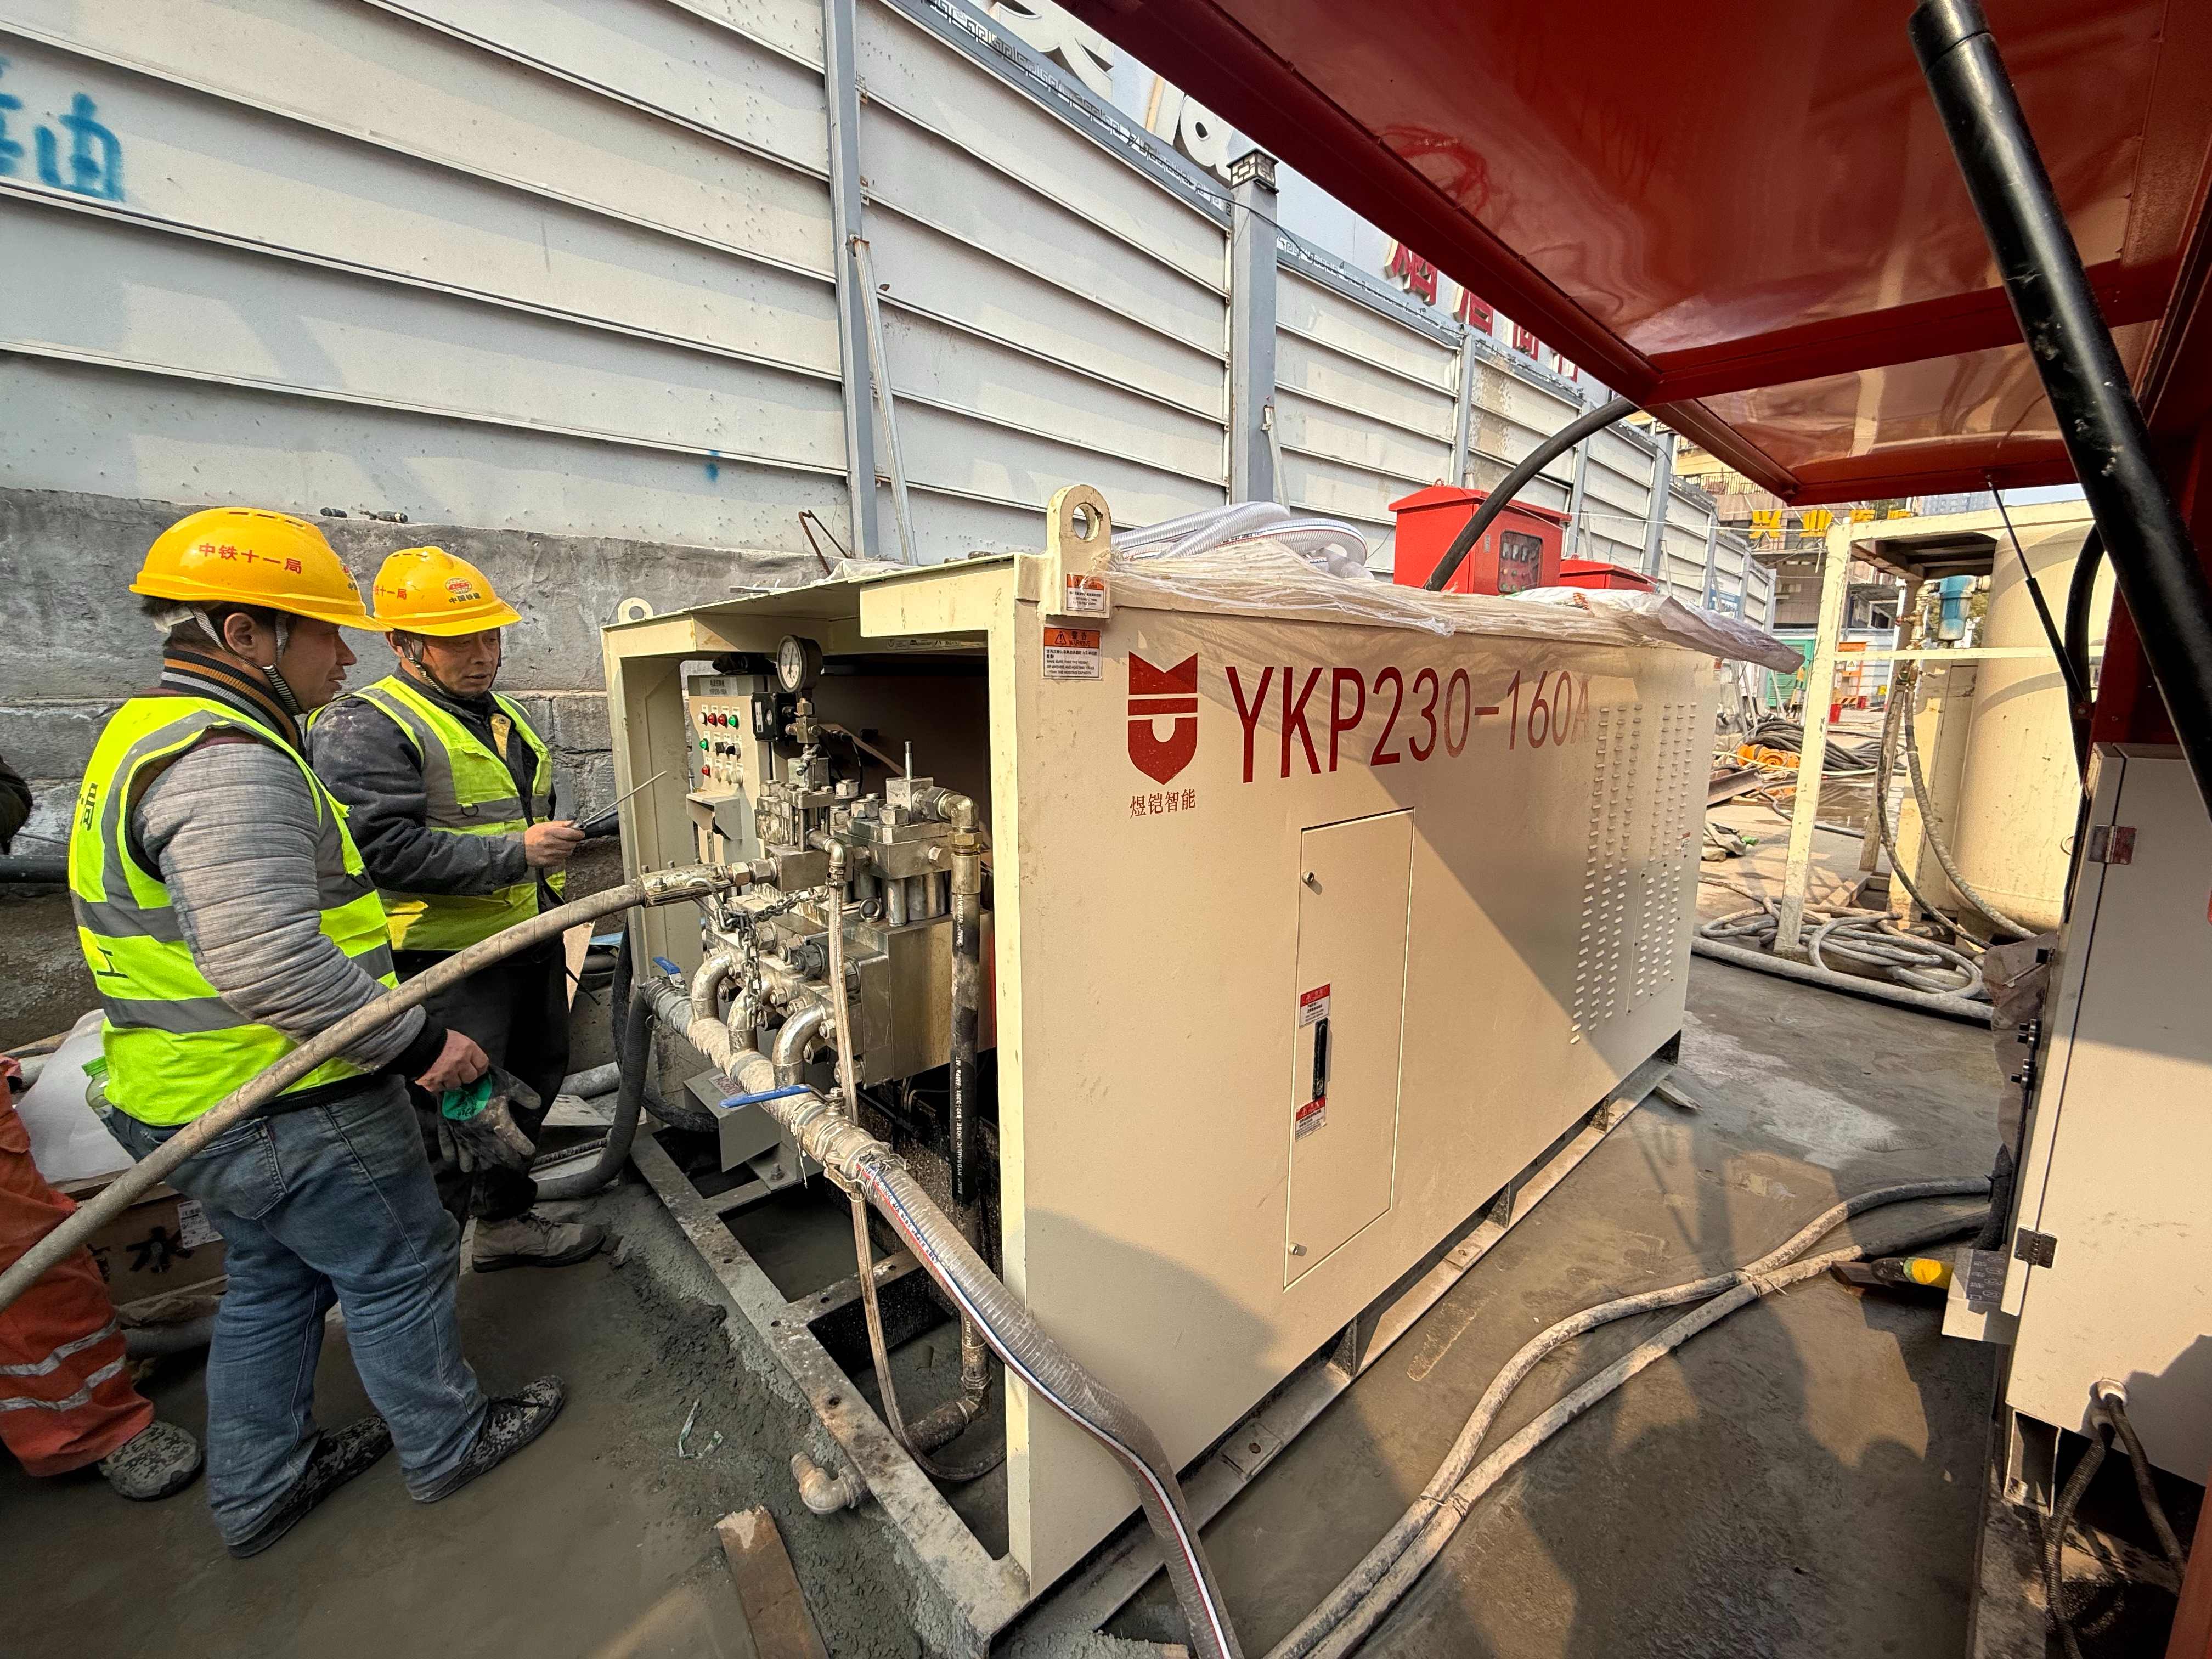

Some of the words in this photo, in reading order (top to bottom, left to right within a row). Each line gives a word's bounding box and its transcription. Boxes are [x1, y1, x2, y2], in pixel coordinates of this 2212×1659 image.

[199, 543, 302, 574] 中铁十一局
[1225, 665, 1590, 783] YKP230-160A
[1130, 788, 1196, 819] 煜铠智能
